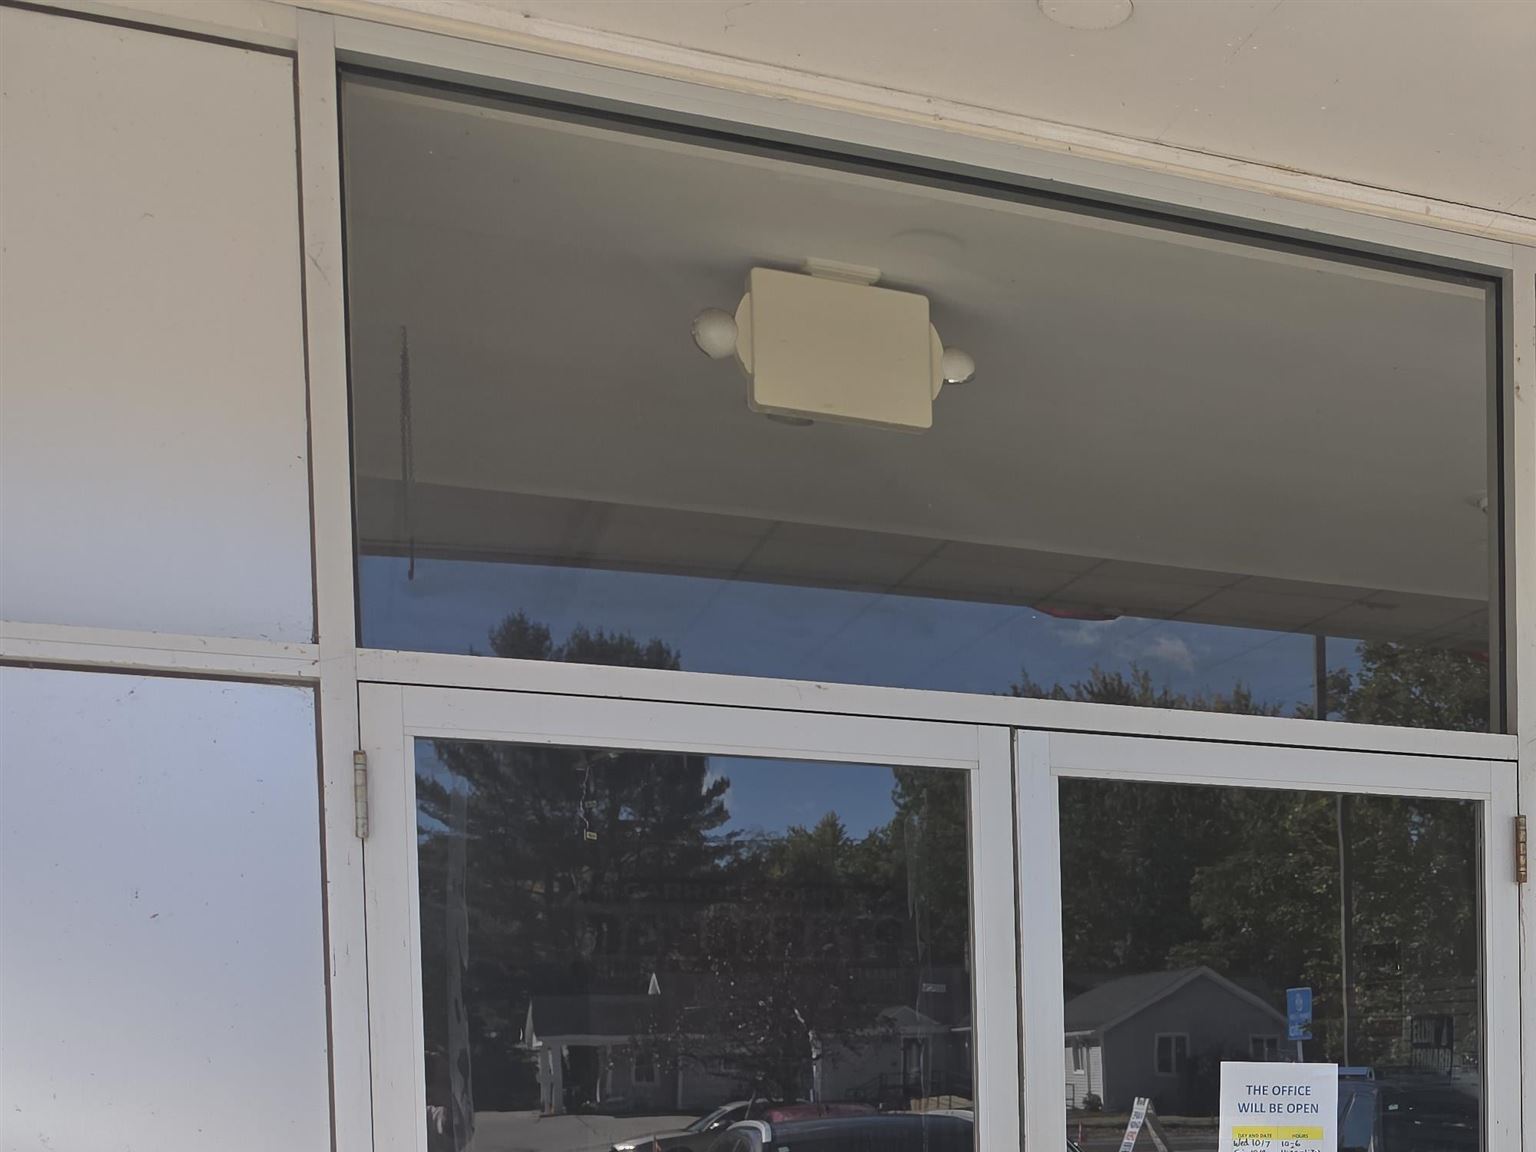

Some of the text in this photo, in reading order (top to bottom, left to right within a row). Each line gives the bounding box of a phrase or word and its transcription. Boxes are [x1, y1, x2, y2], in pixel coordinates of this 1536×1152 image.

[1246, 1085, 1311, 1096] THE OFFICE
[1238, 1102, 1319, 1114] WILL BE OPEN
[1233, 1139, 1249, 1148] Wed
[1251, 1140, 1271, 1149] 10/7
